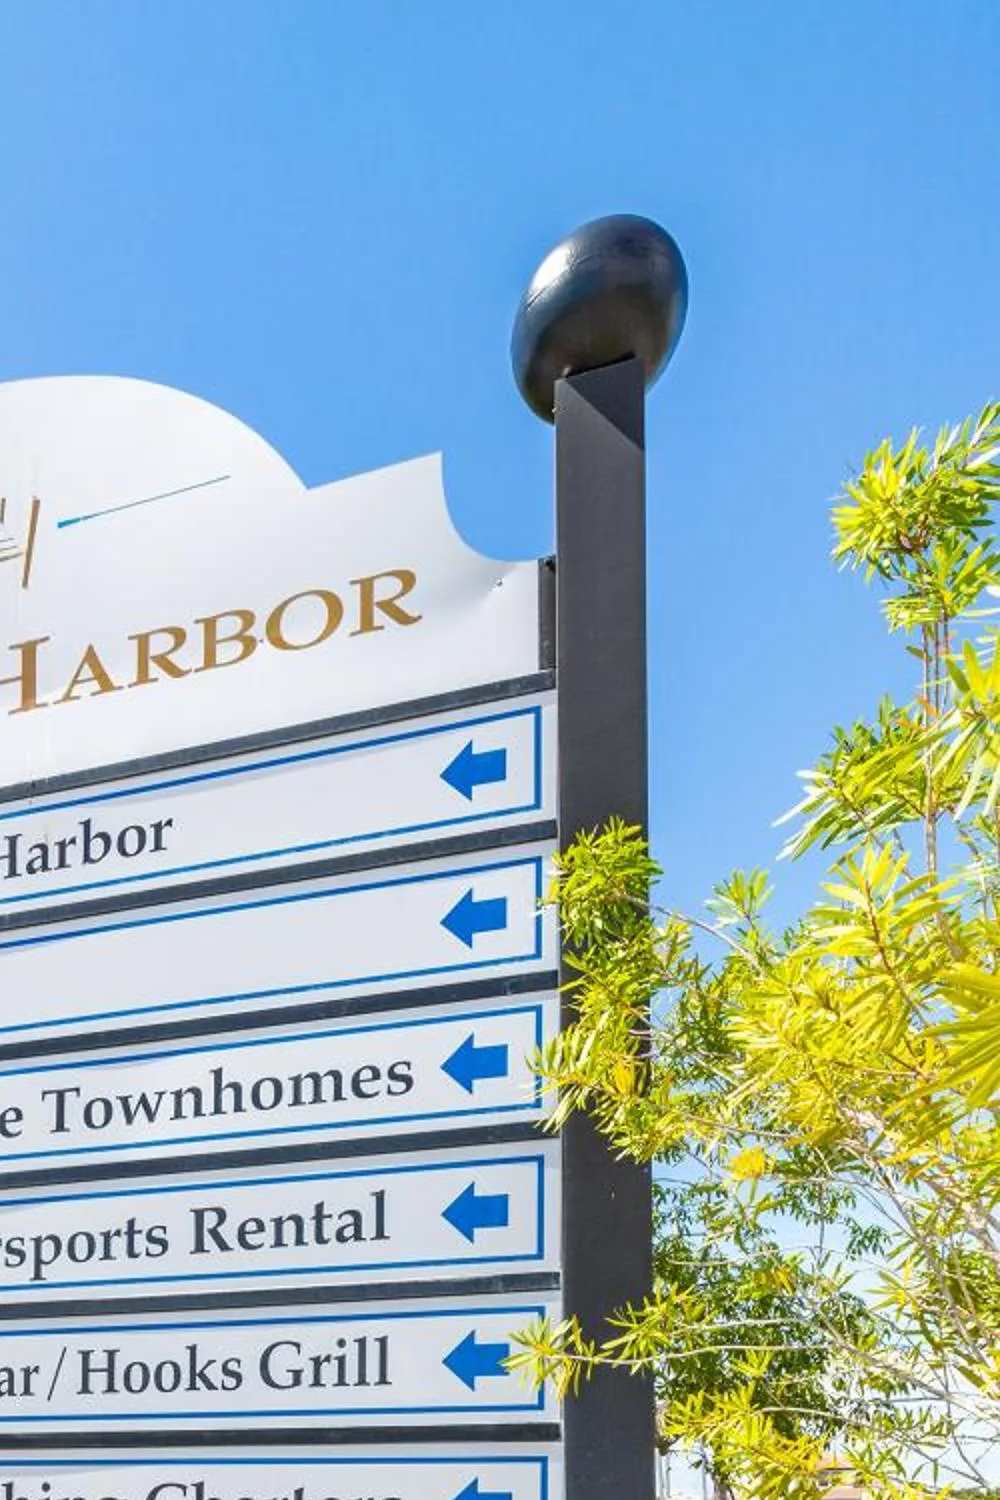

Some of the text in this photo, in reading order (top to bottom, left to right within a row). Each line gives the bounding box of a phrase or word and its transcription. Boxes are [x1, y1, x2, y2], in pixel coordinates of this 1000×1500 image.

[41, 1057, 415, 1134] Townhomes
[189, 1190, 392, 1255] Rental
[77, 1343, 244, 1396] Hooks
[259, 1335, 393, 1390] Grill
